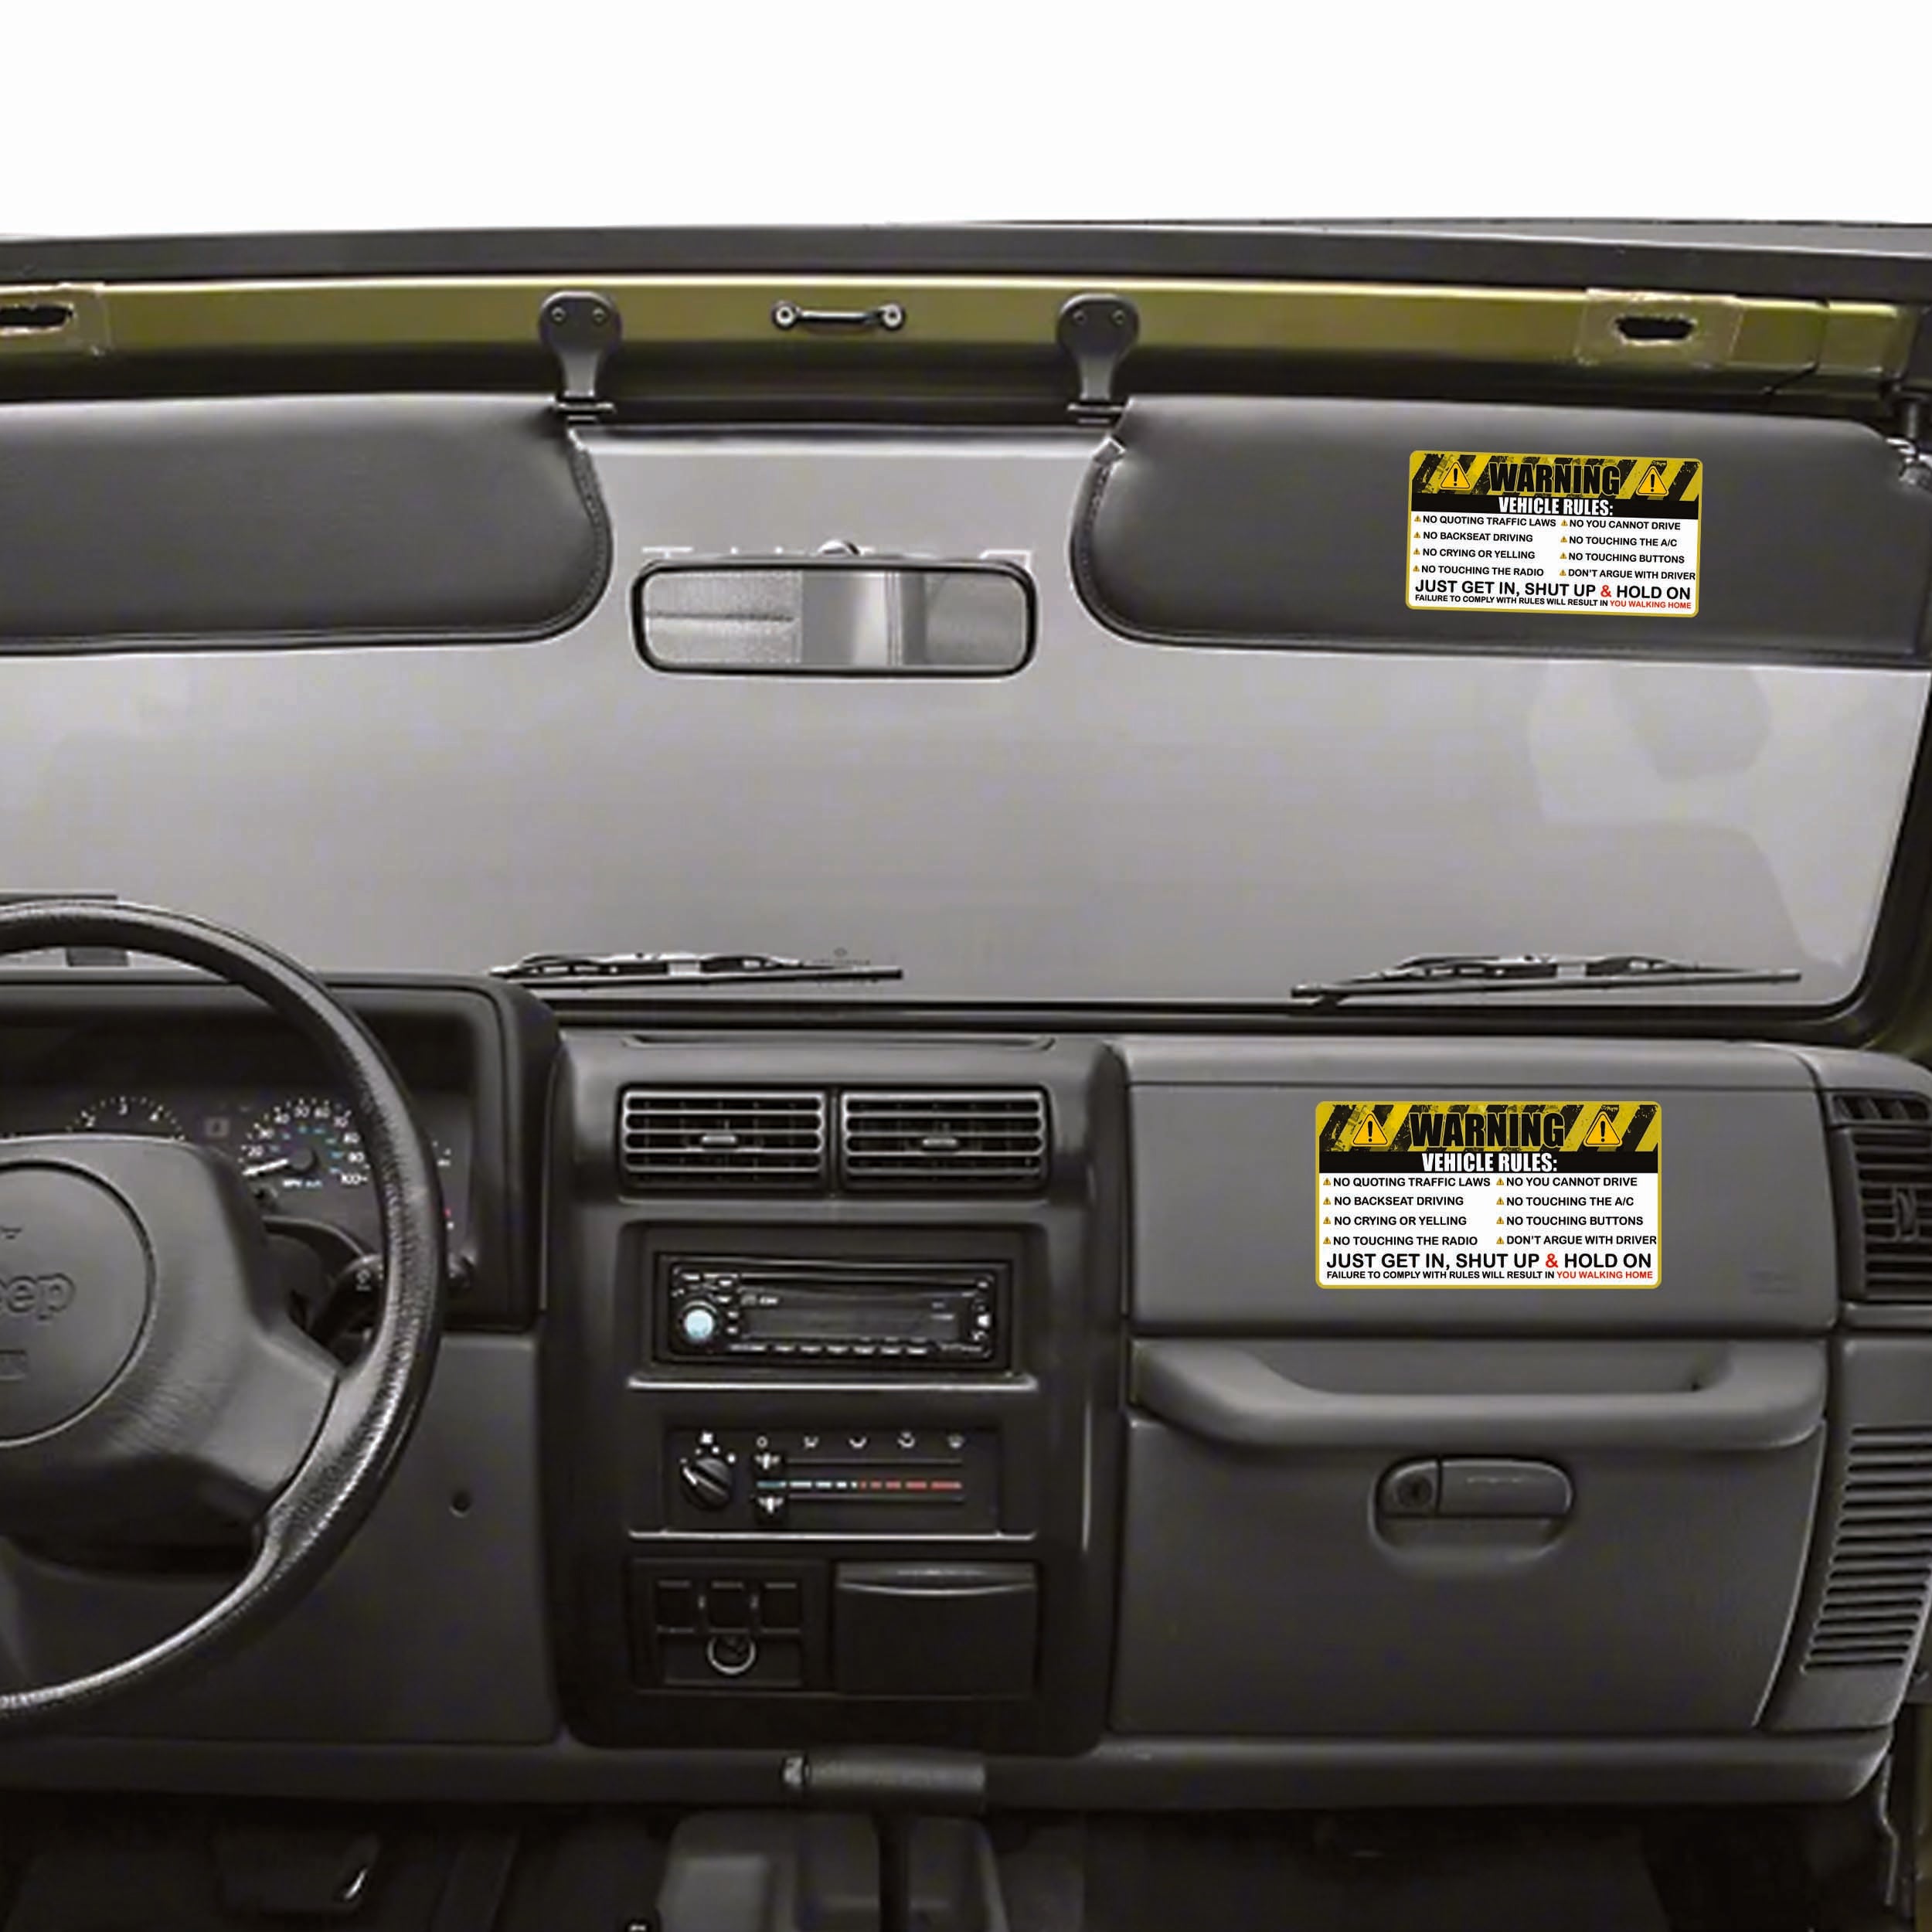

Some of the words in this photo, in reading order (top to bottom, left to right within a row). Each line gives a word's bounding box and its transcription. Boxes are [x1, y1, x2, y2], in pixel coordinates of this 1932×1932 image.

[1488, 462, 1621, 495] WARNING
[1499, 497, 1559, 514] VEHICLE
[1563, 499, 1613, 515] RULES:
[1440, 516, 1484, 525] QUOTING
[1486, 517, 1526, 526] TRAFFIC
[1586, 536, 1637, 546] TOUCHING
[1440, 549, 1475, 557] CRYING
[1495, 550, 1535, 559] YELLING
[1586, 553, 1636, 562] TOUCHING
[1640, 555, 1685, 563] BUTTONS
[1438, 566, 1489, 574] TOUCHING
[1600, 570, 1632, 578] ARGUE
[1416, 580, 1458, 593] JUST
[1462, 581, 1495, 594] GET
[1500, 582, 1519, 597] IN,
[1525, 583, 1570, 596] SHUT
[1574, 584, 1595, 597] UP
[1600, 585, 1611, 597] &
[1617, 585, 1662, 598] HOLD
[1667, 587, 1690, 600] ON
[1410, 1113, 1565, 1148] WARNING
[1422, 1153, 1493, 1172] VEHICLE
[1499, 1153, 1556, 1172] RULES:
[1334, 1178, 1350, 1186] NO
[1353, 1178, 1405, 1187] QUOTING
[1408, 1178, 1455, 1186] TRAFFIC
[1459, 1178, 1490, 1186] LAWS
[1507, 1178, 1523, 1186] NO
[1526, 1178, 1549, 1186] YOU
[1553, 1178, 1600, 1186] CANNOT
[1604, 1178, 1637, 1186] DRIVE
[1335, 1196, 1351, 1206] NO
[1355, 1196, 1413, 1206] BACKSEAT
[1417, 1196, 1463, 1206] DRIVING
[1507, 1197, 1523, 1206] NO
[1526, 1197, 1586, 1206] TOUCHING
[1590, 1197, 1611, 1206] THE
[1615, 1197, 1634, 1206] A/C
[1335, 1216, 1351, 1225] NO
[1354, 1216, 1396, 1225] CRYING
[1400, 1216, 1416, 1225] OR
[1419, 1216, 1466, 1225] YELLING
[1507, 1216, 1523, 1225] NO
[1526, 1216, 1587, 1225] TOUCHING
[1590, 1216, 1643, 1225] BUTTONS
[1334, 1236, 1350, 1245] NO
[1353, 1236, 1413, 1245] TOUCHING
[1417, 1236, 1438, 1245] THE
[1442, 1236, 1478, 1245] RADIO
[1507, 1236, 1541, 1244] DON'T
[1543, 1236, 1582, 1244] ARGUE
[1585, 1236, 1613, 1244] WITH
[1617, 1236, 1656, 1244] DRIVER
[1327, 1253, 1376, 1268] JUST
[1382, 1253, 1420, 1268] GET
[1427, 1253, 1450, 1270] IN,
[1456, 1253, 1509, 1268] SHUT
[1515, 1253, 1539, 1268] UP
[1546, 1253, 1558, 1267] &
[1565, 1253, 1617, 1268] HOLD
[1624, 1253, 1651, 1268] ON
[0, 1273, 77, 1321] ep
